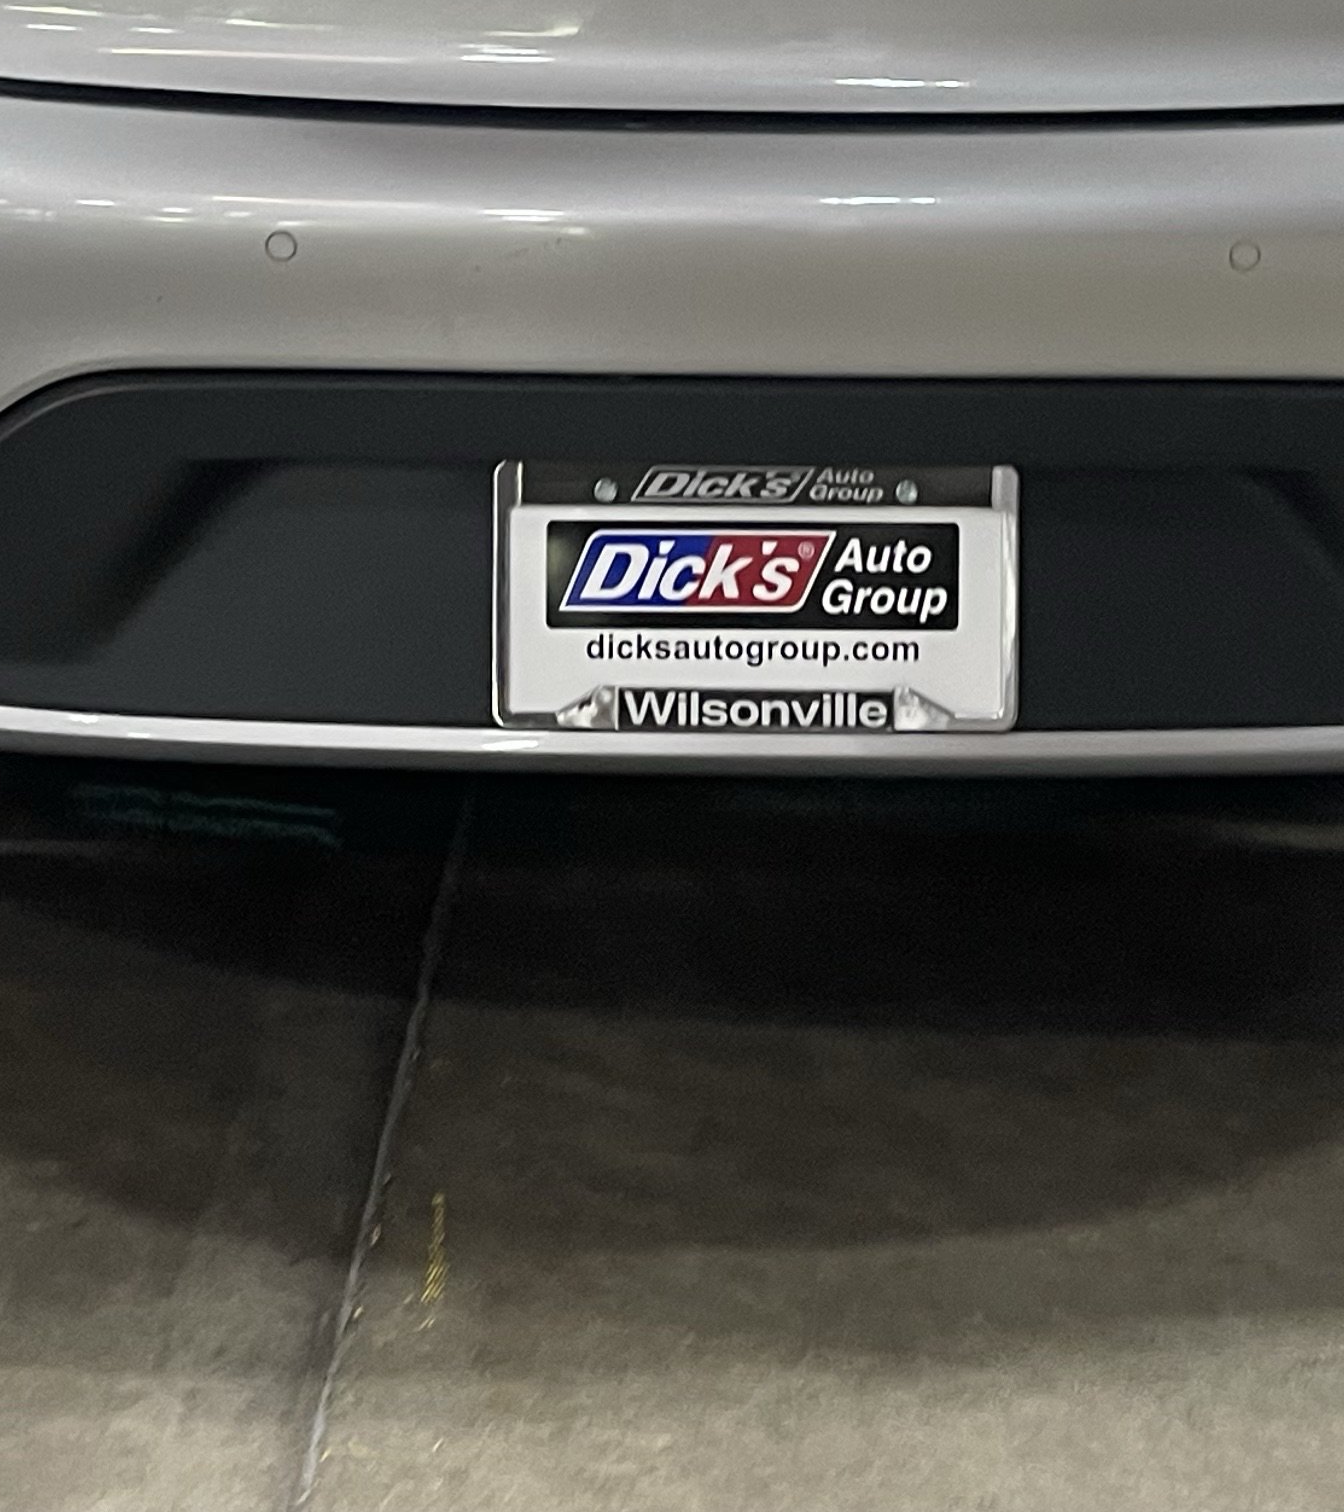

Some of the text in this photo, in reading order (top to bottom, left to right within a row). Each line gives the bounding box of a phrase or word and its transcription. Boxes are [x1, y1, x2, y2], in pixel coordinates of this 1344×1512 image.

[644, 468, 792, 499] Dick's
[816, 467, 875, 485] Auto
[809, 485, 884, 503] Group
[578, 539, 800, 602] Dick's
[834, 538, 932, 573] Auto
[821, 579, 947, 624] Group
[586, 633, 920, 666] dicksautogroup.com
[623, 690, 888, 727] Wilsonville
